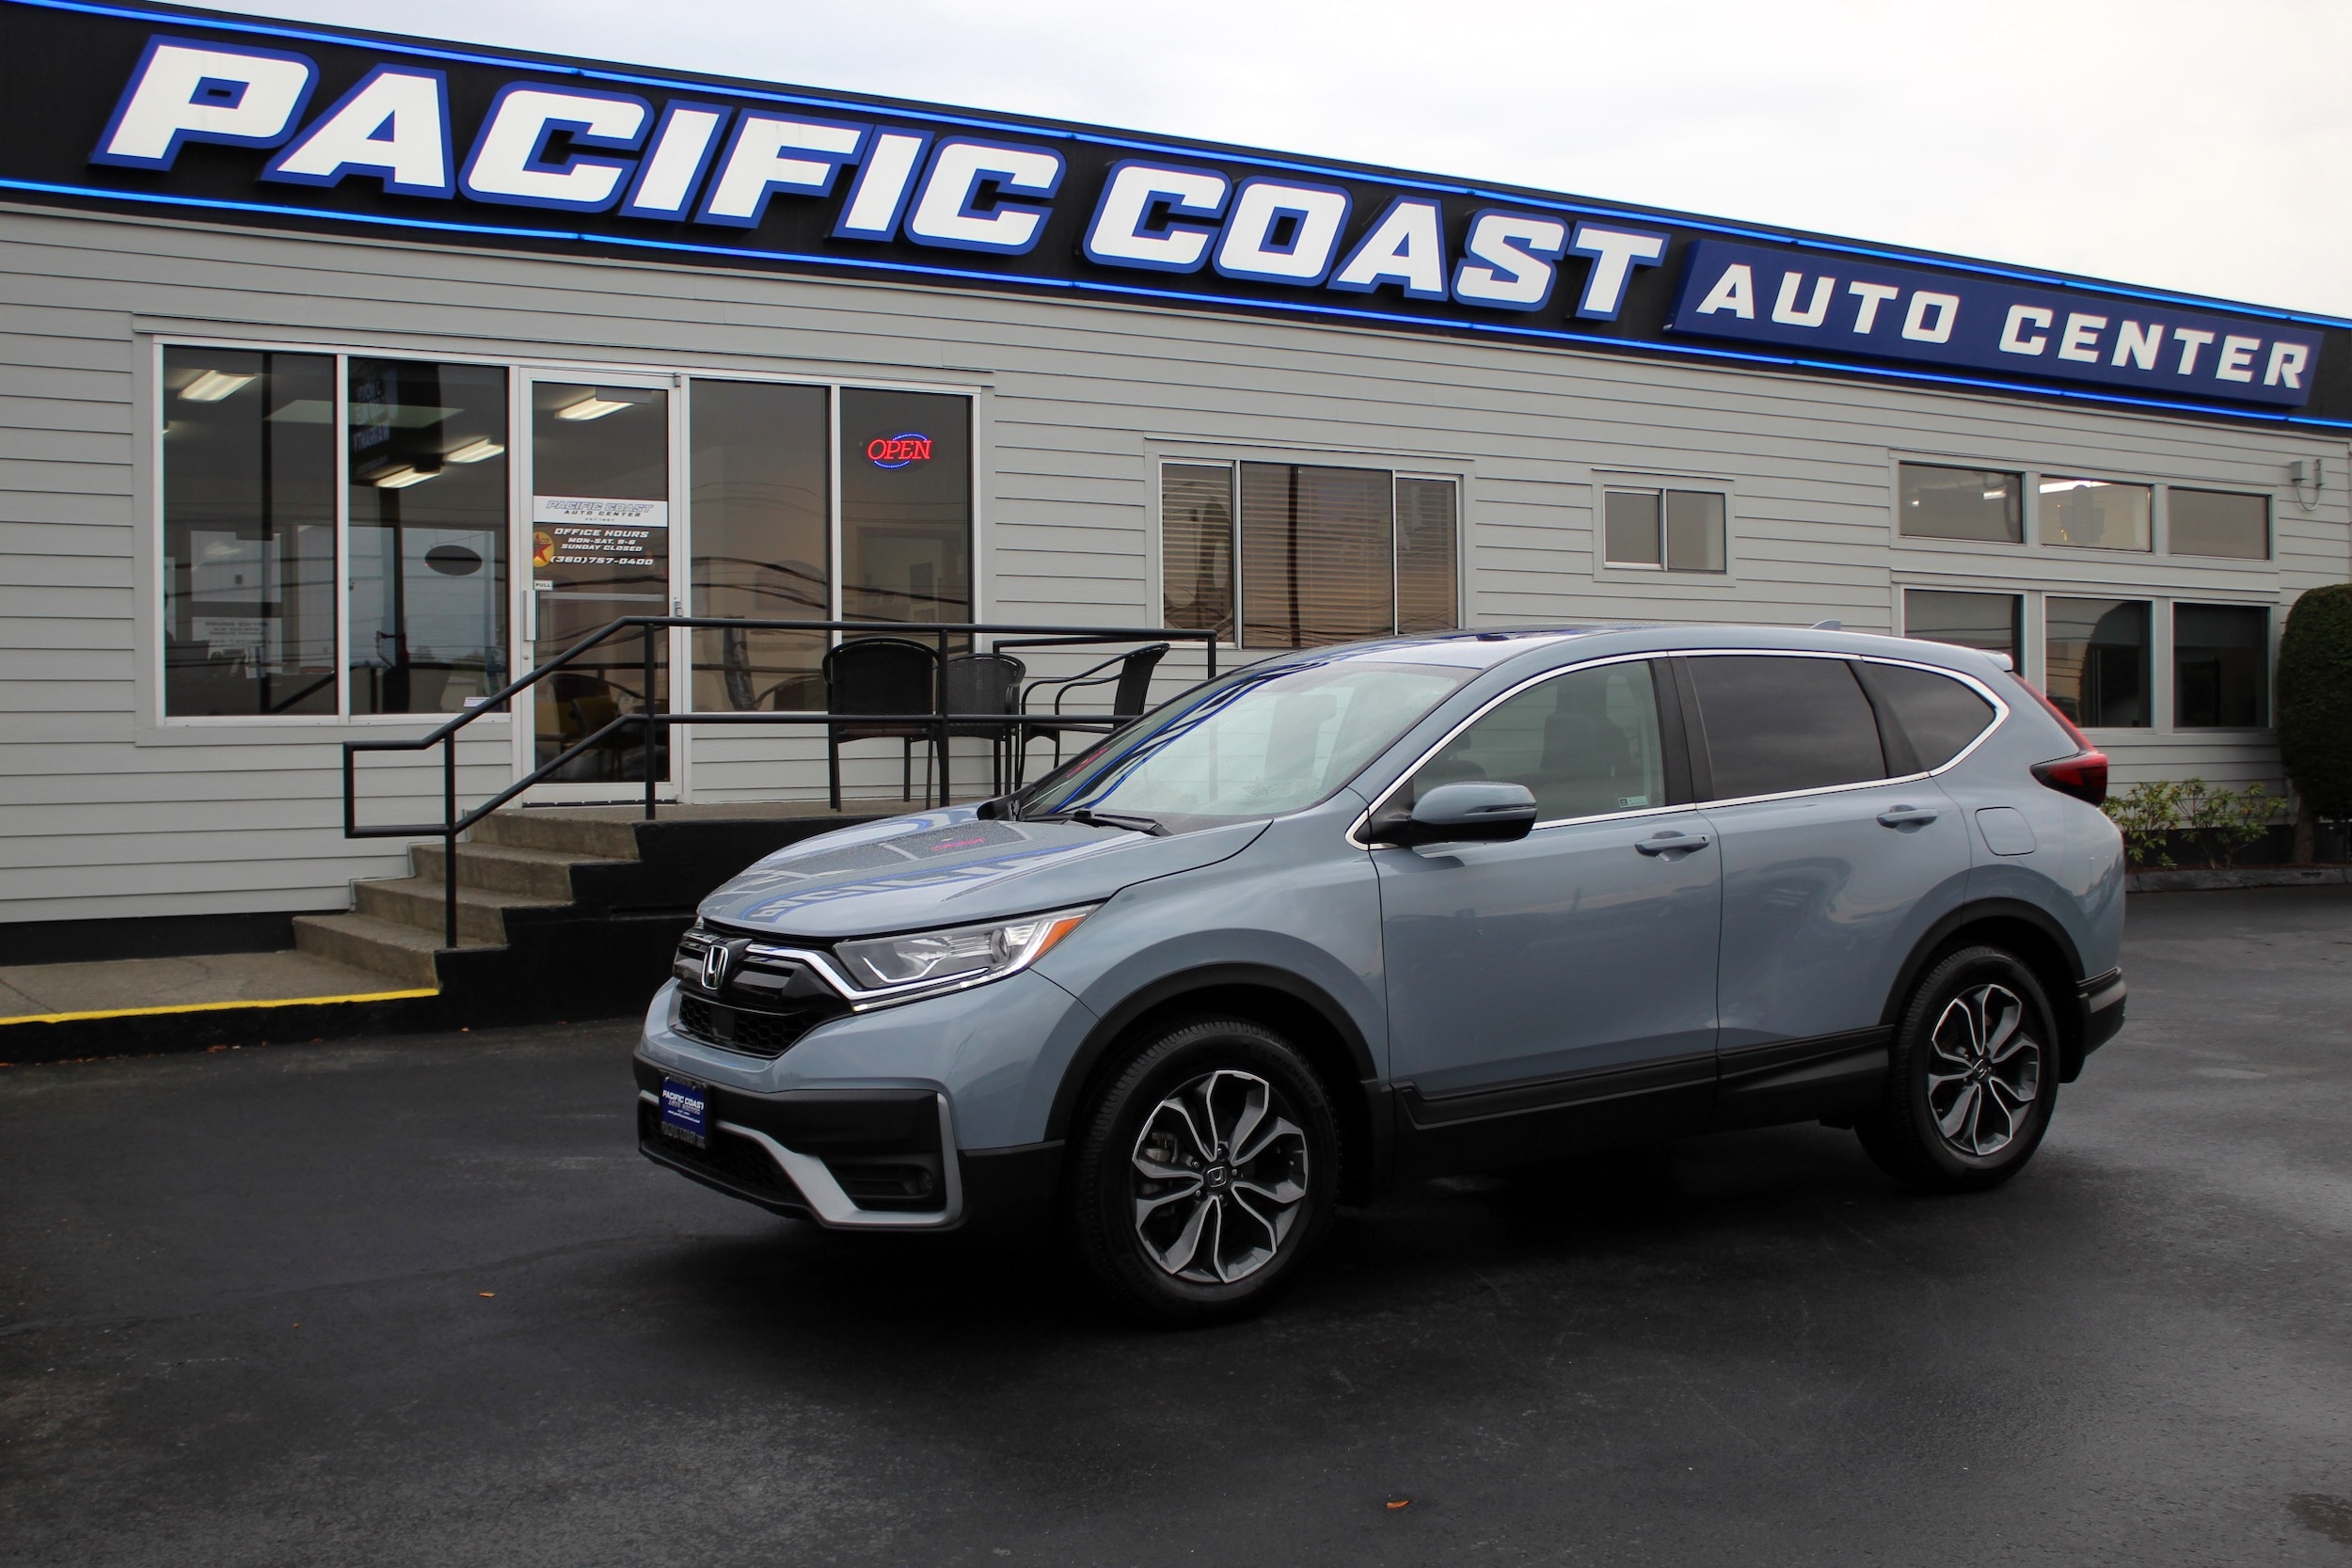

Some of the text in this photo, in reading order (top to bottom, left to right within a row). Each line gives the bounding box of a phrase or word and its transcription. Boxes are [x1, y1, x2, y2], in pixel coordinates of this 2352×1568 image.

[92, 36, 1669, 320] PACIFIC COAST
[1695, 262, 2311, 390] AUTO CENTER
[866, 438, 932, 460] OPEN
[546, 500, 654, 513] PACIFIC COAST
[554, 528, 602, 537] OFFICE
[662, 1090, 704, 1110] PACIFIC COAST
